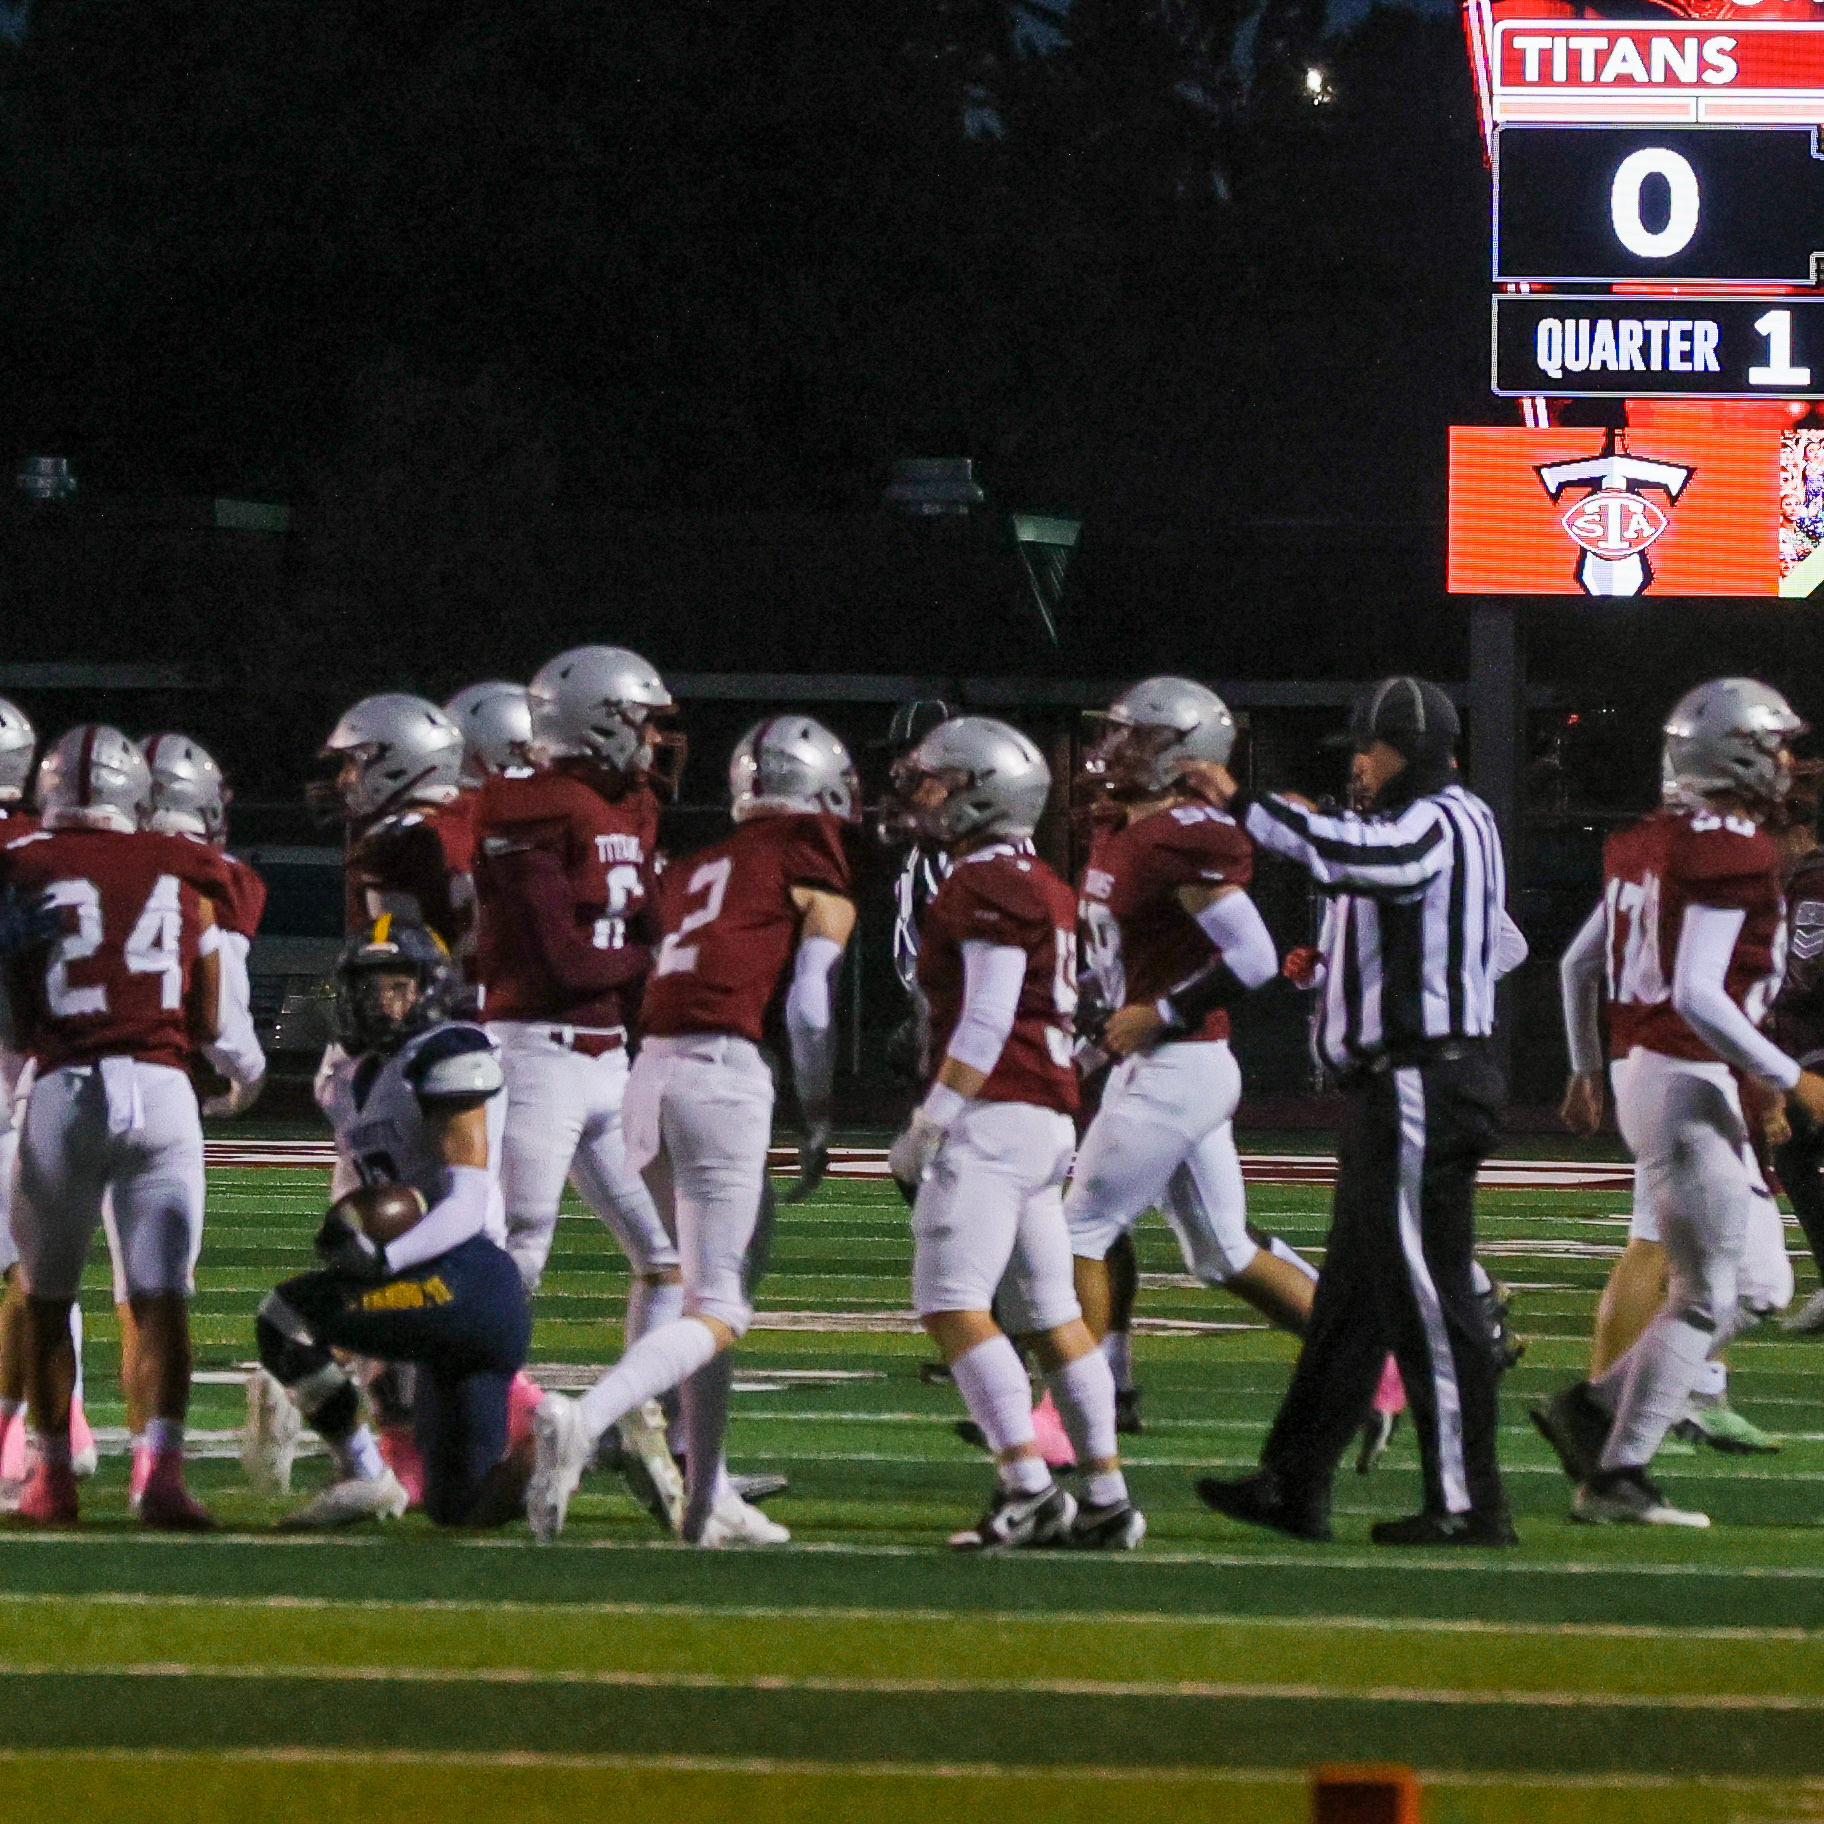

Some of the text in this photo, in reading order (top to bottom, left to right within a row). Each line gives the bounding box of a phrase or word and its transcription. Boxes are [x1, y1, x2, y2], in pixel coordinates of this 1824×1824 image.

[1512, 35, 1740, 86] TITANS
[1610, 146, 1701, 259] 0
[1535, 308, 1812, 386] QUARTER 1
[42, 873, 183, 1016] 24
